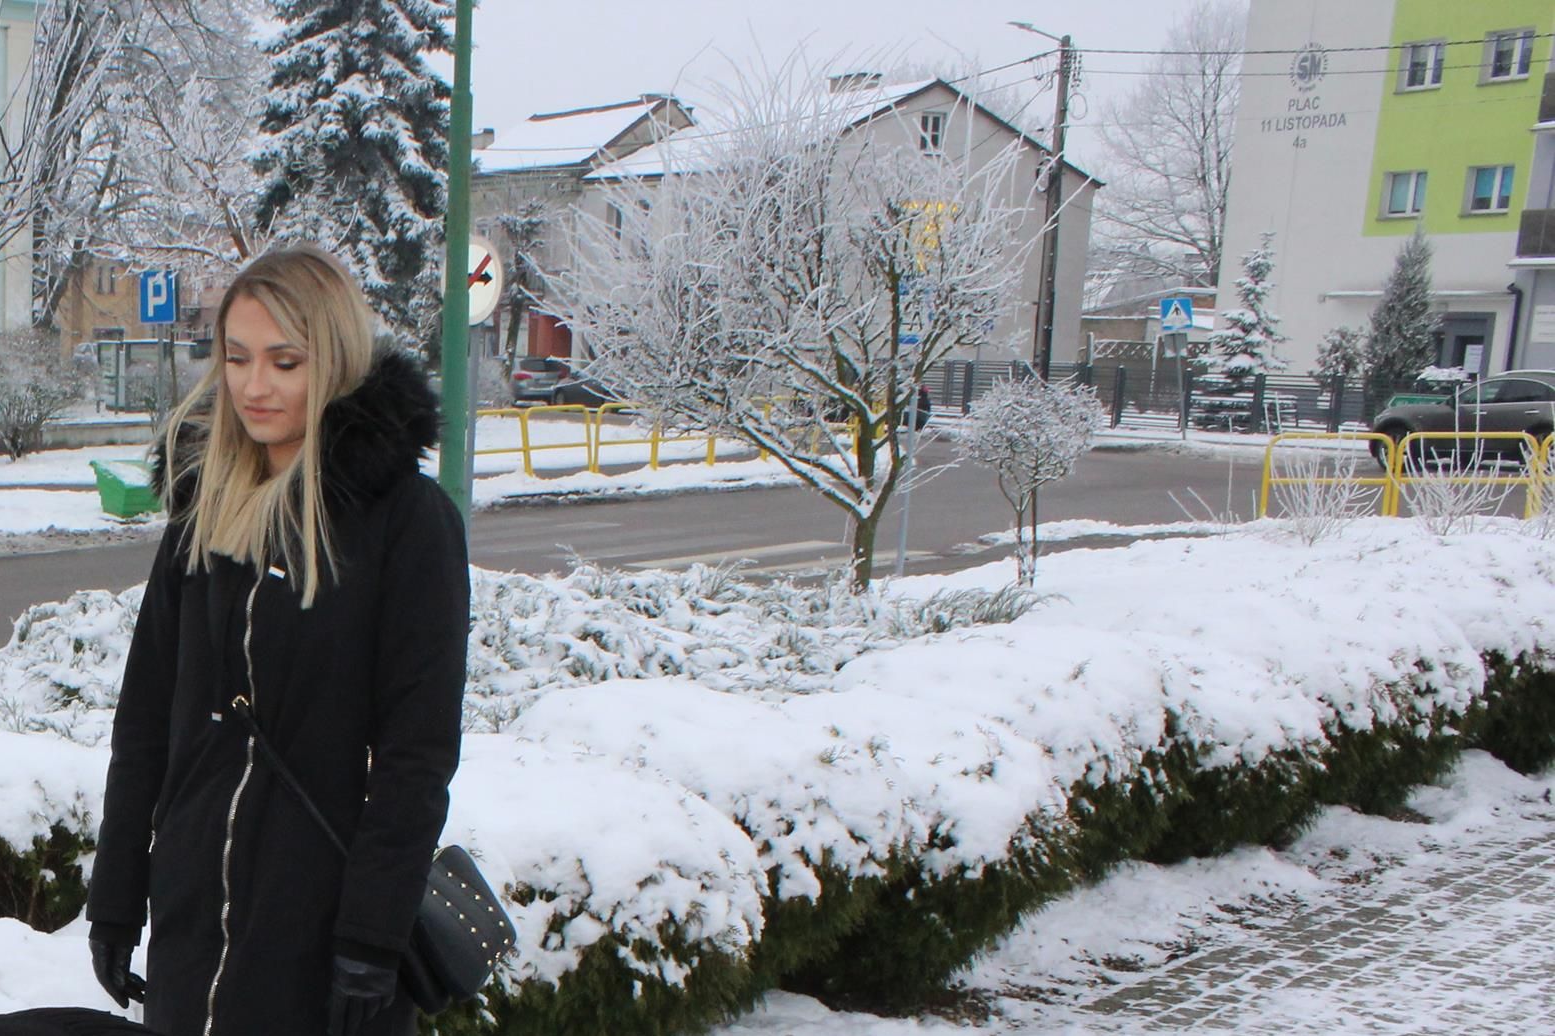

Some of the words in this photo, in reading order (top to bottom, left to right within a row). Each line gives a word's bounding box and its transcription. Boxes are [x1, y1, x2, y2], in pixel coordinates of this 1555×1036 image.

[1288, 96, 1320, 112] PLAC
[1261, 120, 1272, 133] 11
[1276, 113, 1347, 132] LISTOPADA
[1292, 135, 1307, 149] 4a
[147, 276, 167, 317] P
